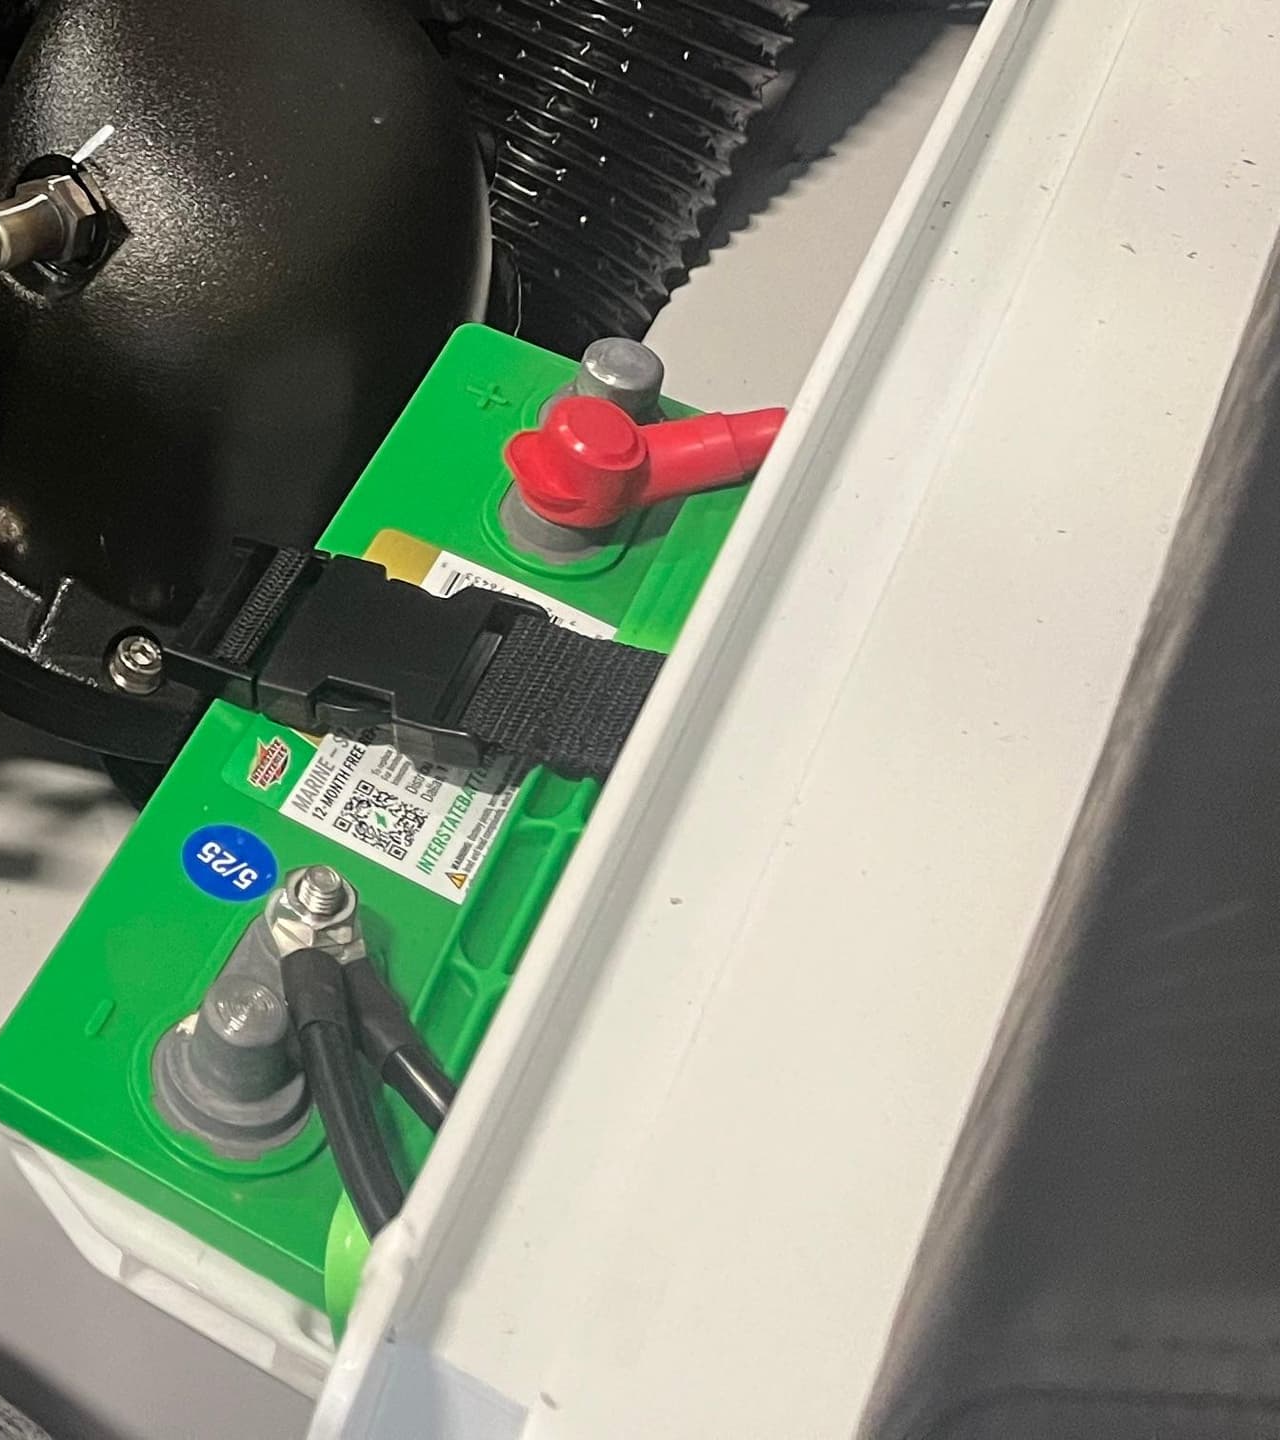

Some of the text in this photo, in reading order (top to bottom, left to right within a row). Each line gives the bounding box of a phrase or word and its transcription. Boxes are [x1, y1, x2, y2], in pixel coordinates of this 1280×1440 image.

[292, 756, 335, 814] MARINE
[312, 767, 350, 822] 12-MONTH
[344, 745, 366, 771] FREE
[195, 840, 260, 892] 5/25
